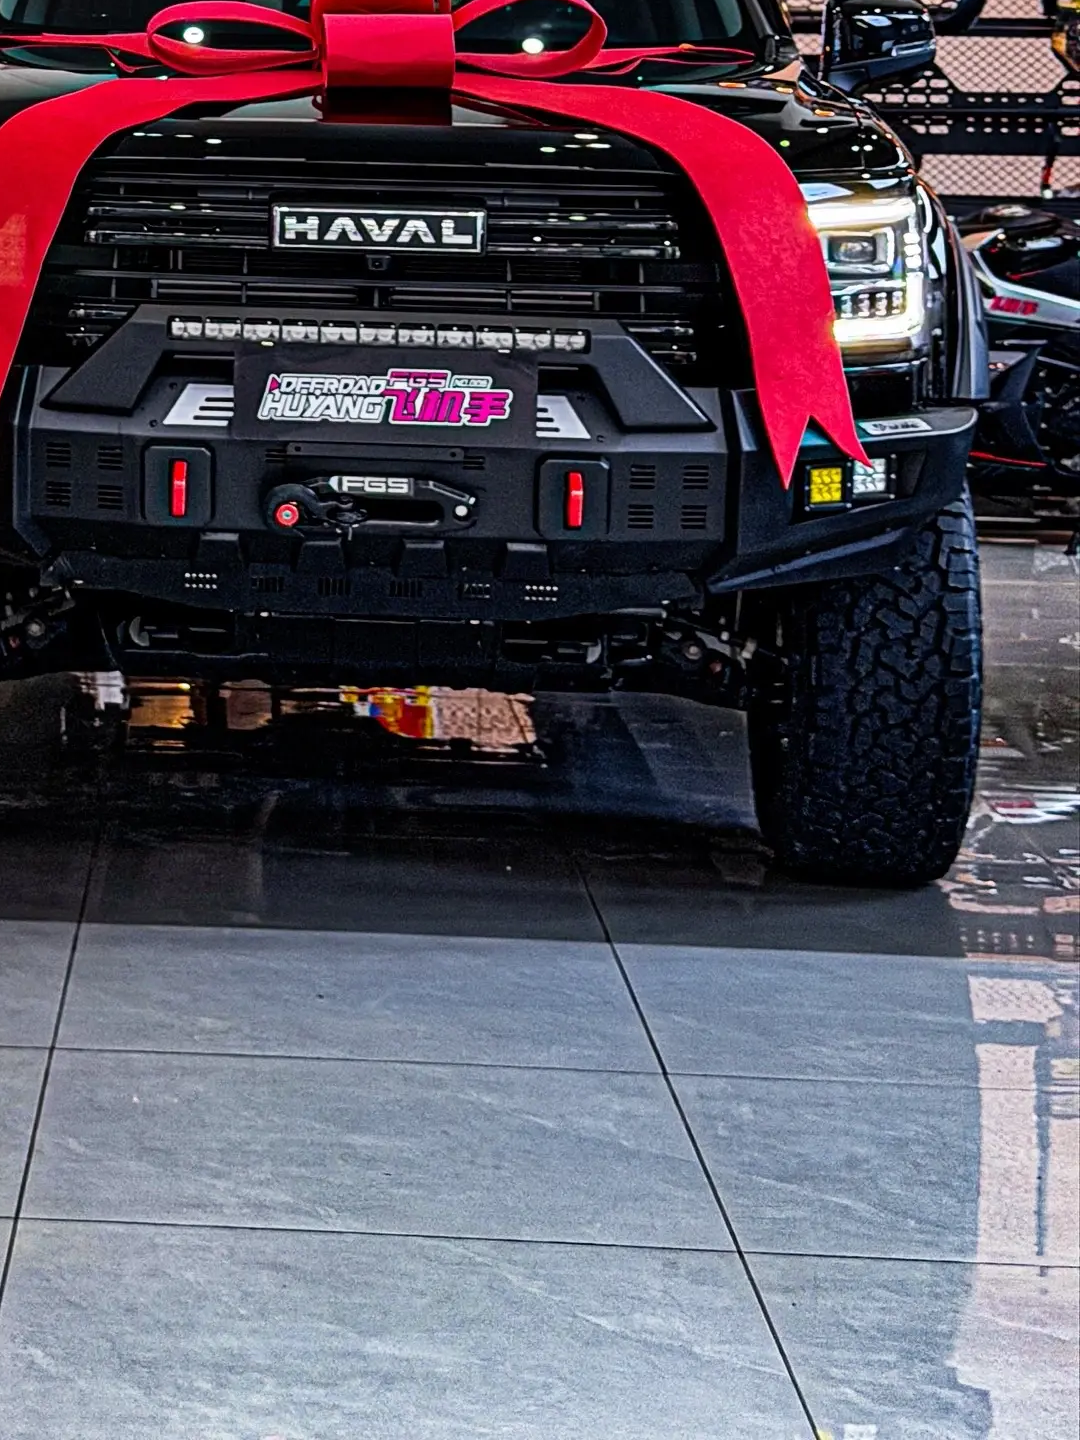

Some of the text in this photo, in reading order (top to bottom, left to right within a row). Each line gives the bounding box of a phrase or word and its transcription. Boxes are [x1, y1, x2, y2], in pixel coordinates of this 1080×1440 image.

[283, 215, 475, 245] HAVAL
[260, 392, 385, 420] HUYANG
[381, 388, 511, 424] 飞机手
[341, 475, 411, 494] FGS
